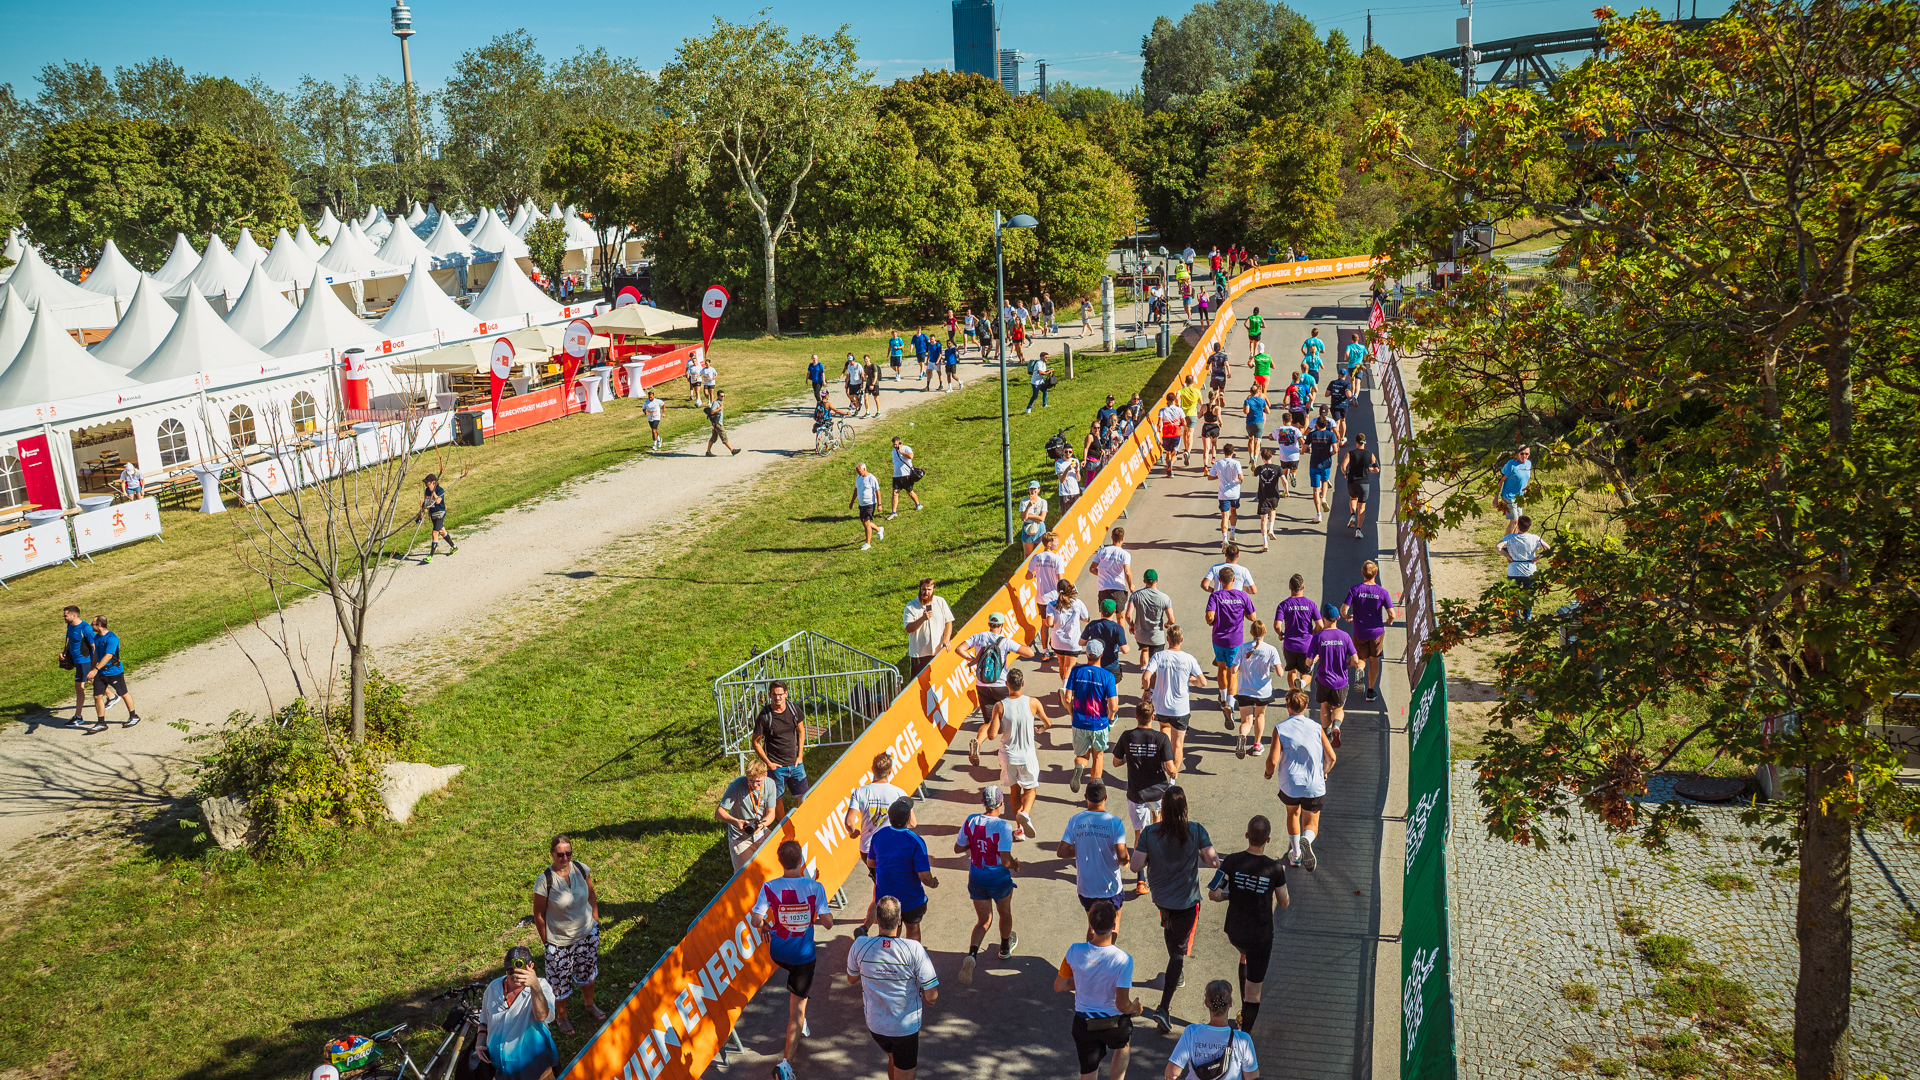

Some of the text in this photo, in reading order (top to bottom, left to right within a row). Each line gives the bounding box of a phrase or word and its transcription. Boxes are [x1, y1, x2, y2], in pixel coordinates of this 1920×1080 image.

[1087, 498, 1105, 527] WIEN
[1358, 592, 1379, 600] ACREDIA
[614, 1011, 681, 1080] IEN
